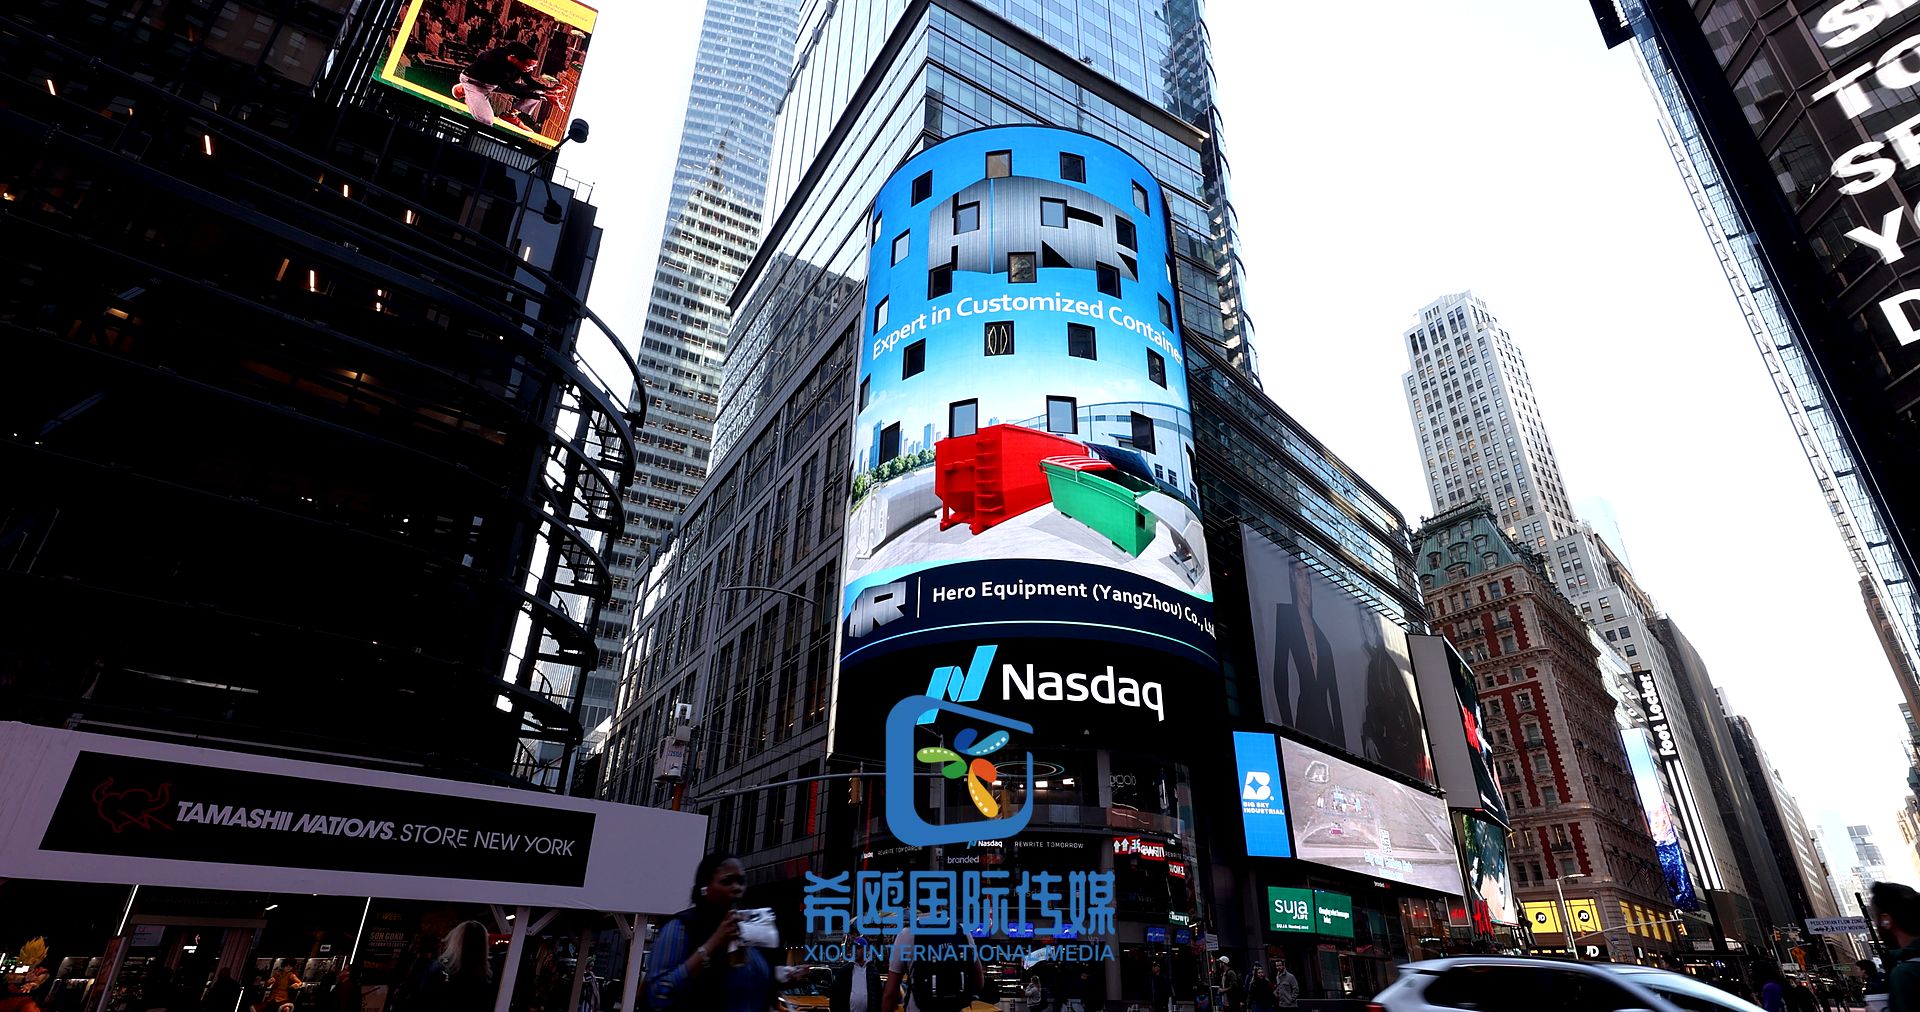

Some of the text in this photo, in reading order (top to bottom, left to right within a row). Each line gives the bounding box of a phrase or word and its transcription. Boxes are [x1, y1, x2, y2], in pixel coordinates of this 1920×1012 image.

[1843, 199, 1920, 267] Y
[872, 313, 928, 361] Expert
[931, 305, 951, 325] in
[956, 292, 1105, 319] Customized
[932, 583, 976, 603] Hero
[981, 578, 1087, 602] Equipment
[1092, 583, 1182, 620] (YangZhou)
[1184, 606, 1204, 632] Co.,
[1002, 663, 1165, 722] Nasdaq
[1639, 673, 1677, 756] Foot Locker
[176, 801, 576, 857] TAMASHII NATIONS STORE NEW YORK
[1243, 807, 1285, 816] INDUSTRIAL
[977, 840, 1003, 849] Nasdaq
[1046, 841, 1084, 849] TOMORROW
[1274, 899, 1308, 919] suja
[1585, 945, 1600, 958] JD
